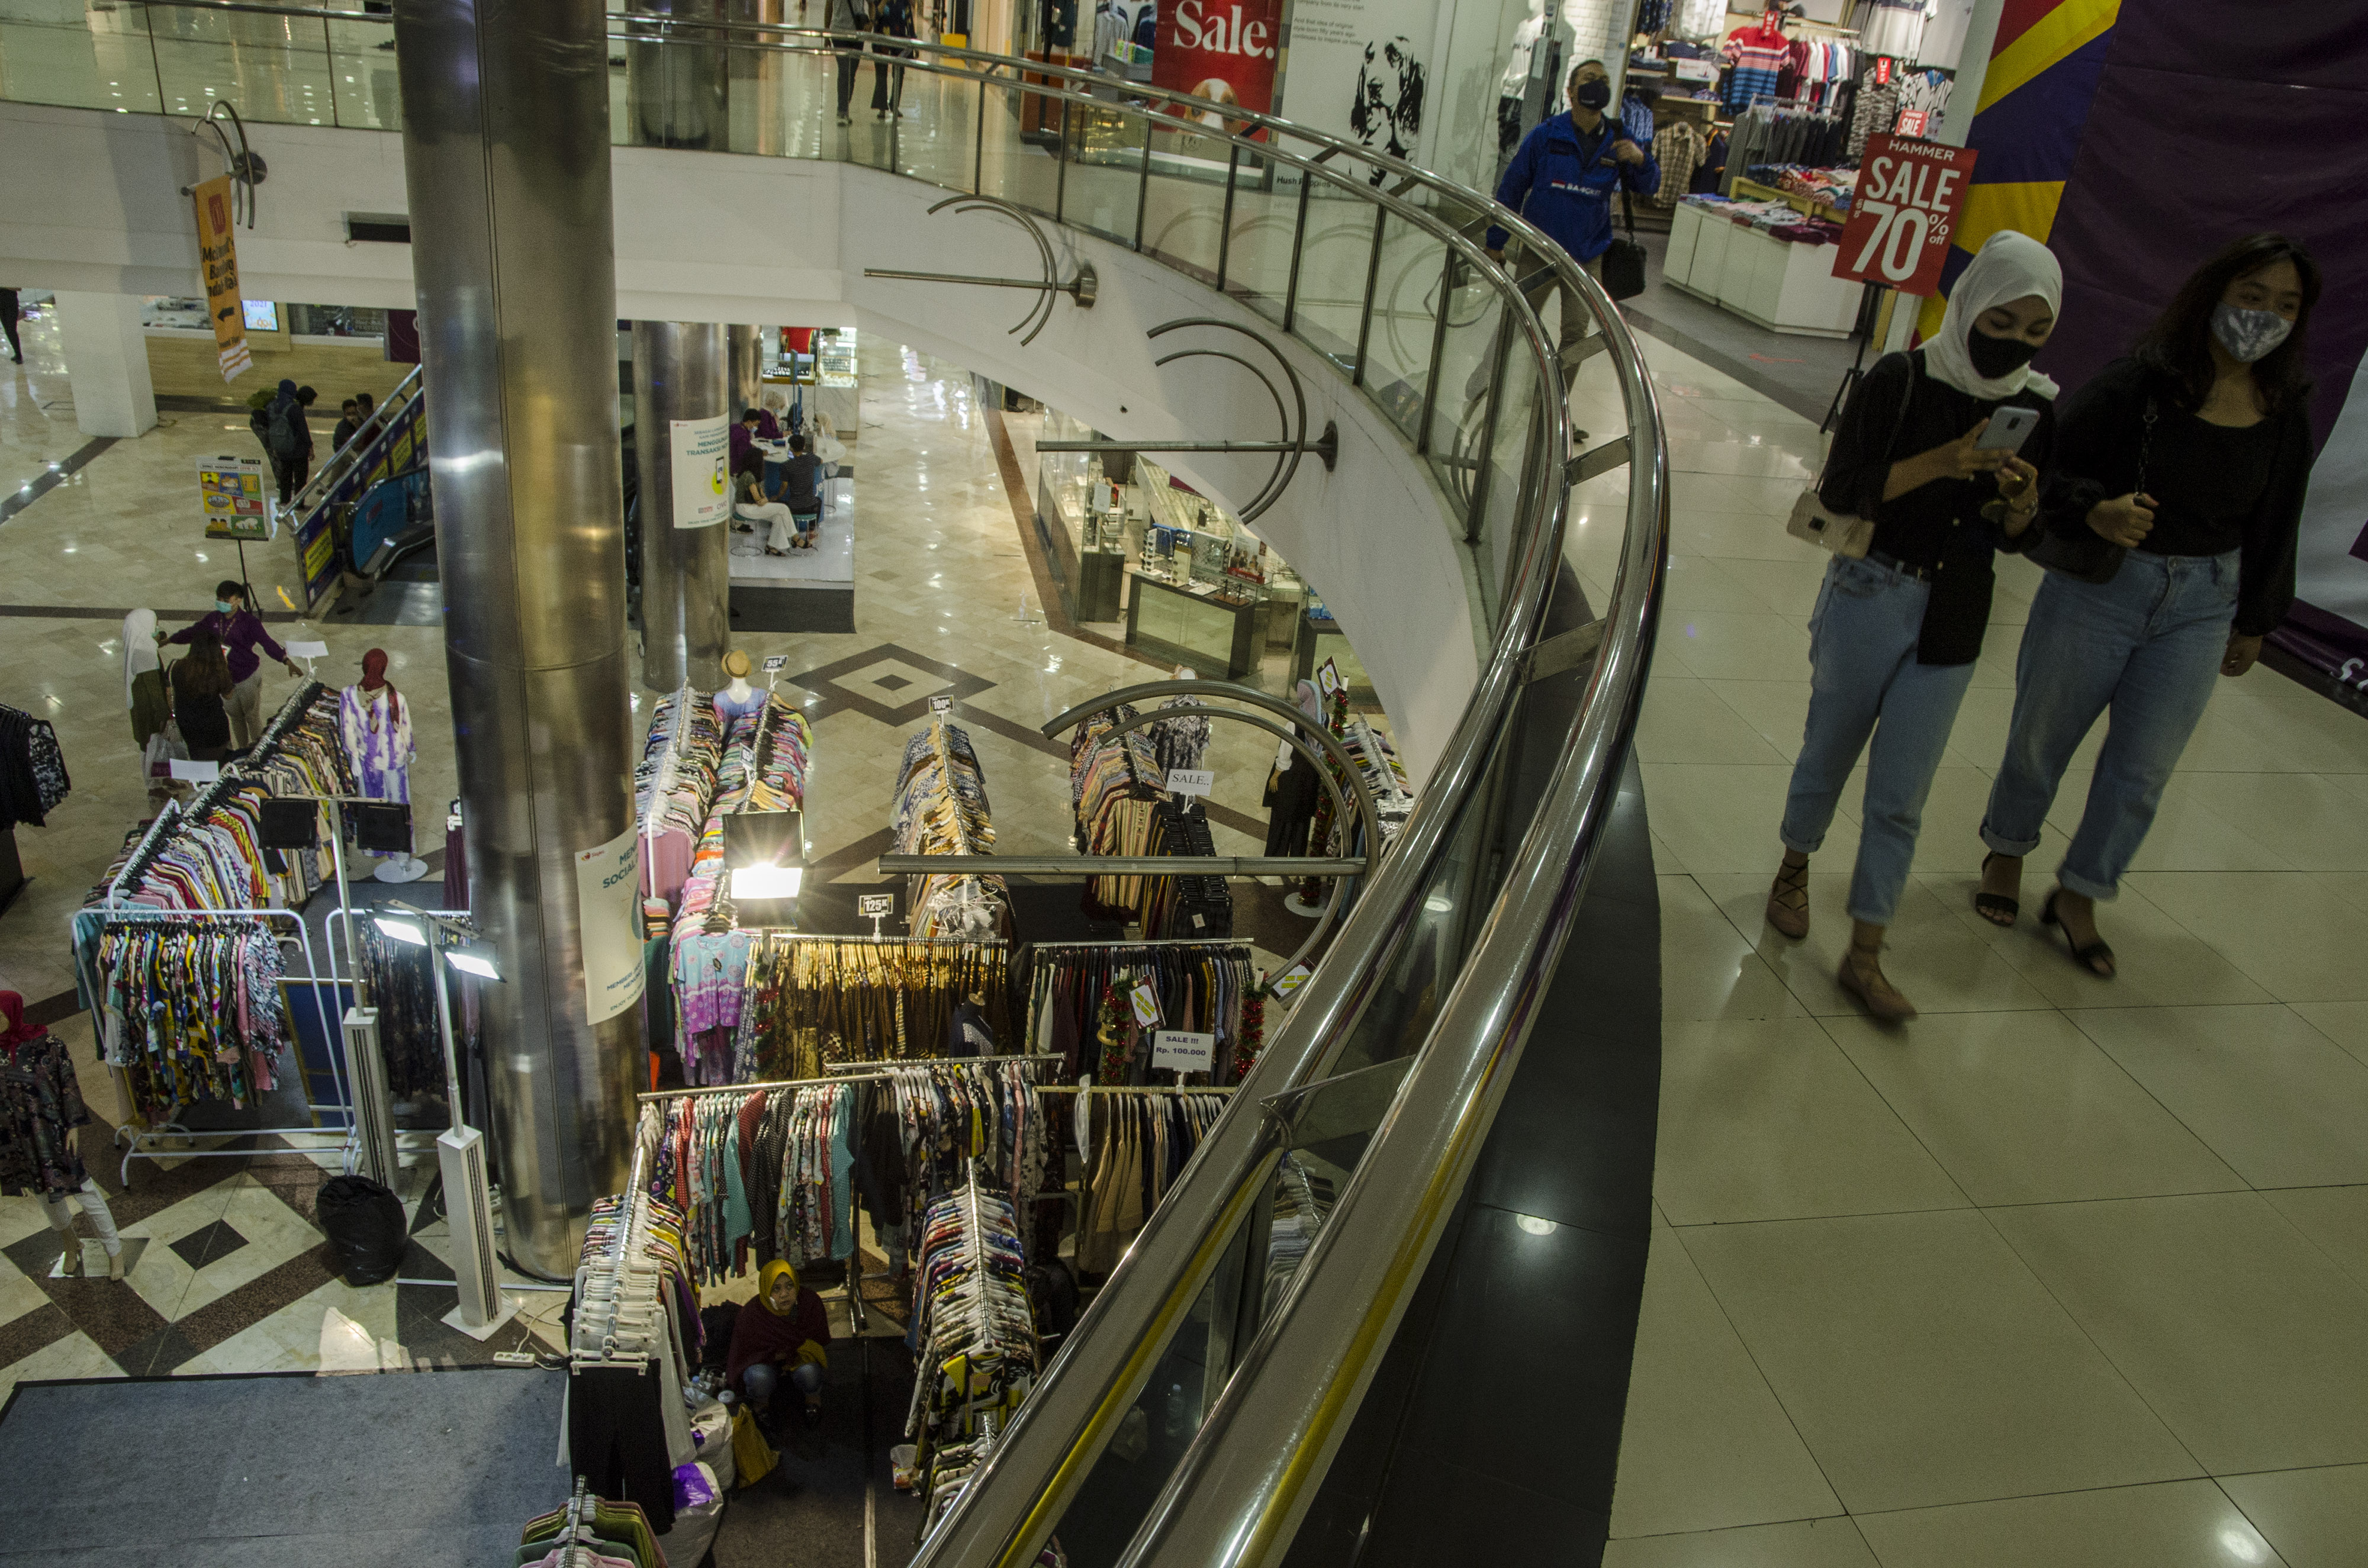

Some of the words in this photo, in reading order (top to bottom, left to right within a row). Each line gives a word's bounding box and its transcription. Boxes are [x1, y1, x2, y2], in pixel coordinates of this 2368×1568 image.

[1173, 0, 1275, 59] Sale.
[1900, 117, 1921, 136] SALE
[1888, 139, 1955, 162] HAMMER
[1276, 175, 1297, 185] Hush
[1865, 156, 1961, 212] SALE
[1929, 236, 1945, 245] off
[686, 445, 720, 456] TRANSAKSI
[933, 698, 950, 710] 100K
[1172, 773, 1209, 785] SALE..
[603, 860, 635, 888] SOCIAL
[865, 899, 887, 912] 125K
[1173, 1048, 1206, 1056] 100.000
